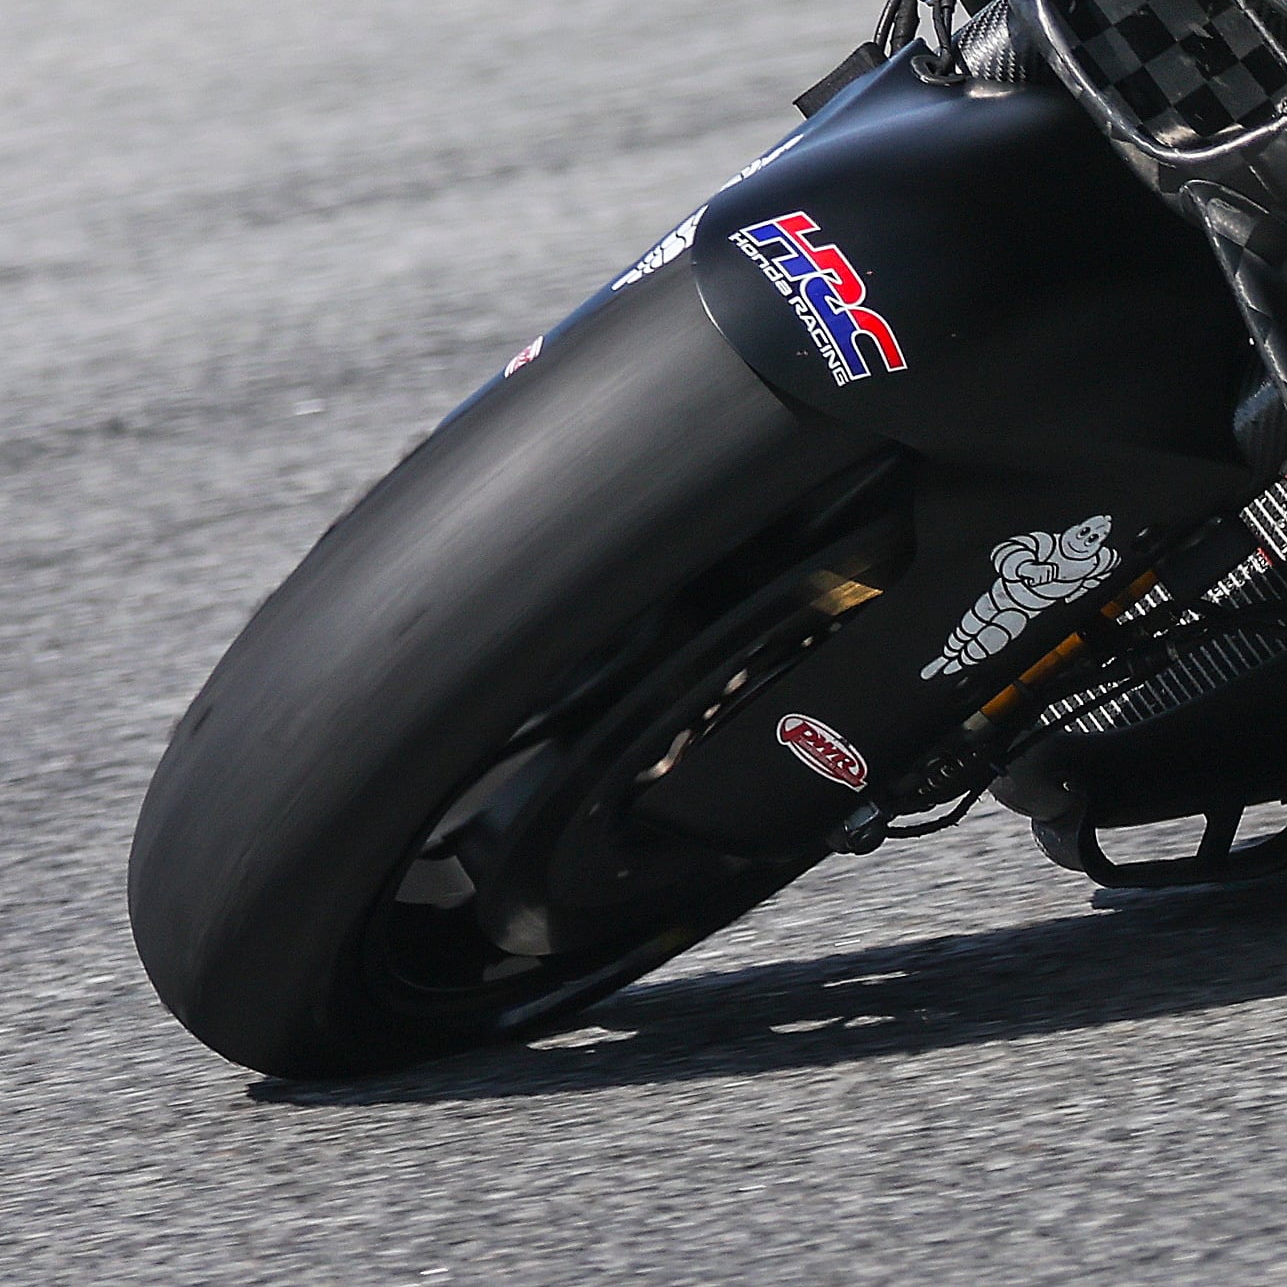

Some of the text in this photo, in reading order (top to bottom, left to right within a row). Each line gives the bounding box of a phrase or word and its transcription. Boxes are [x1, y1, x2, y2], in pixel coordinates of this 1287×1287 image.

[727, 231, 851, 388] Honda RACING
[738, 210, 909, 382] HRC
